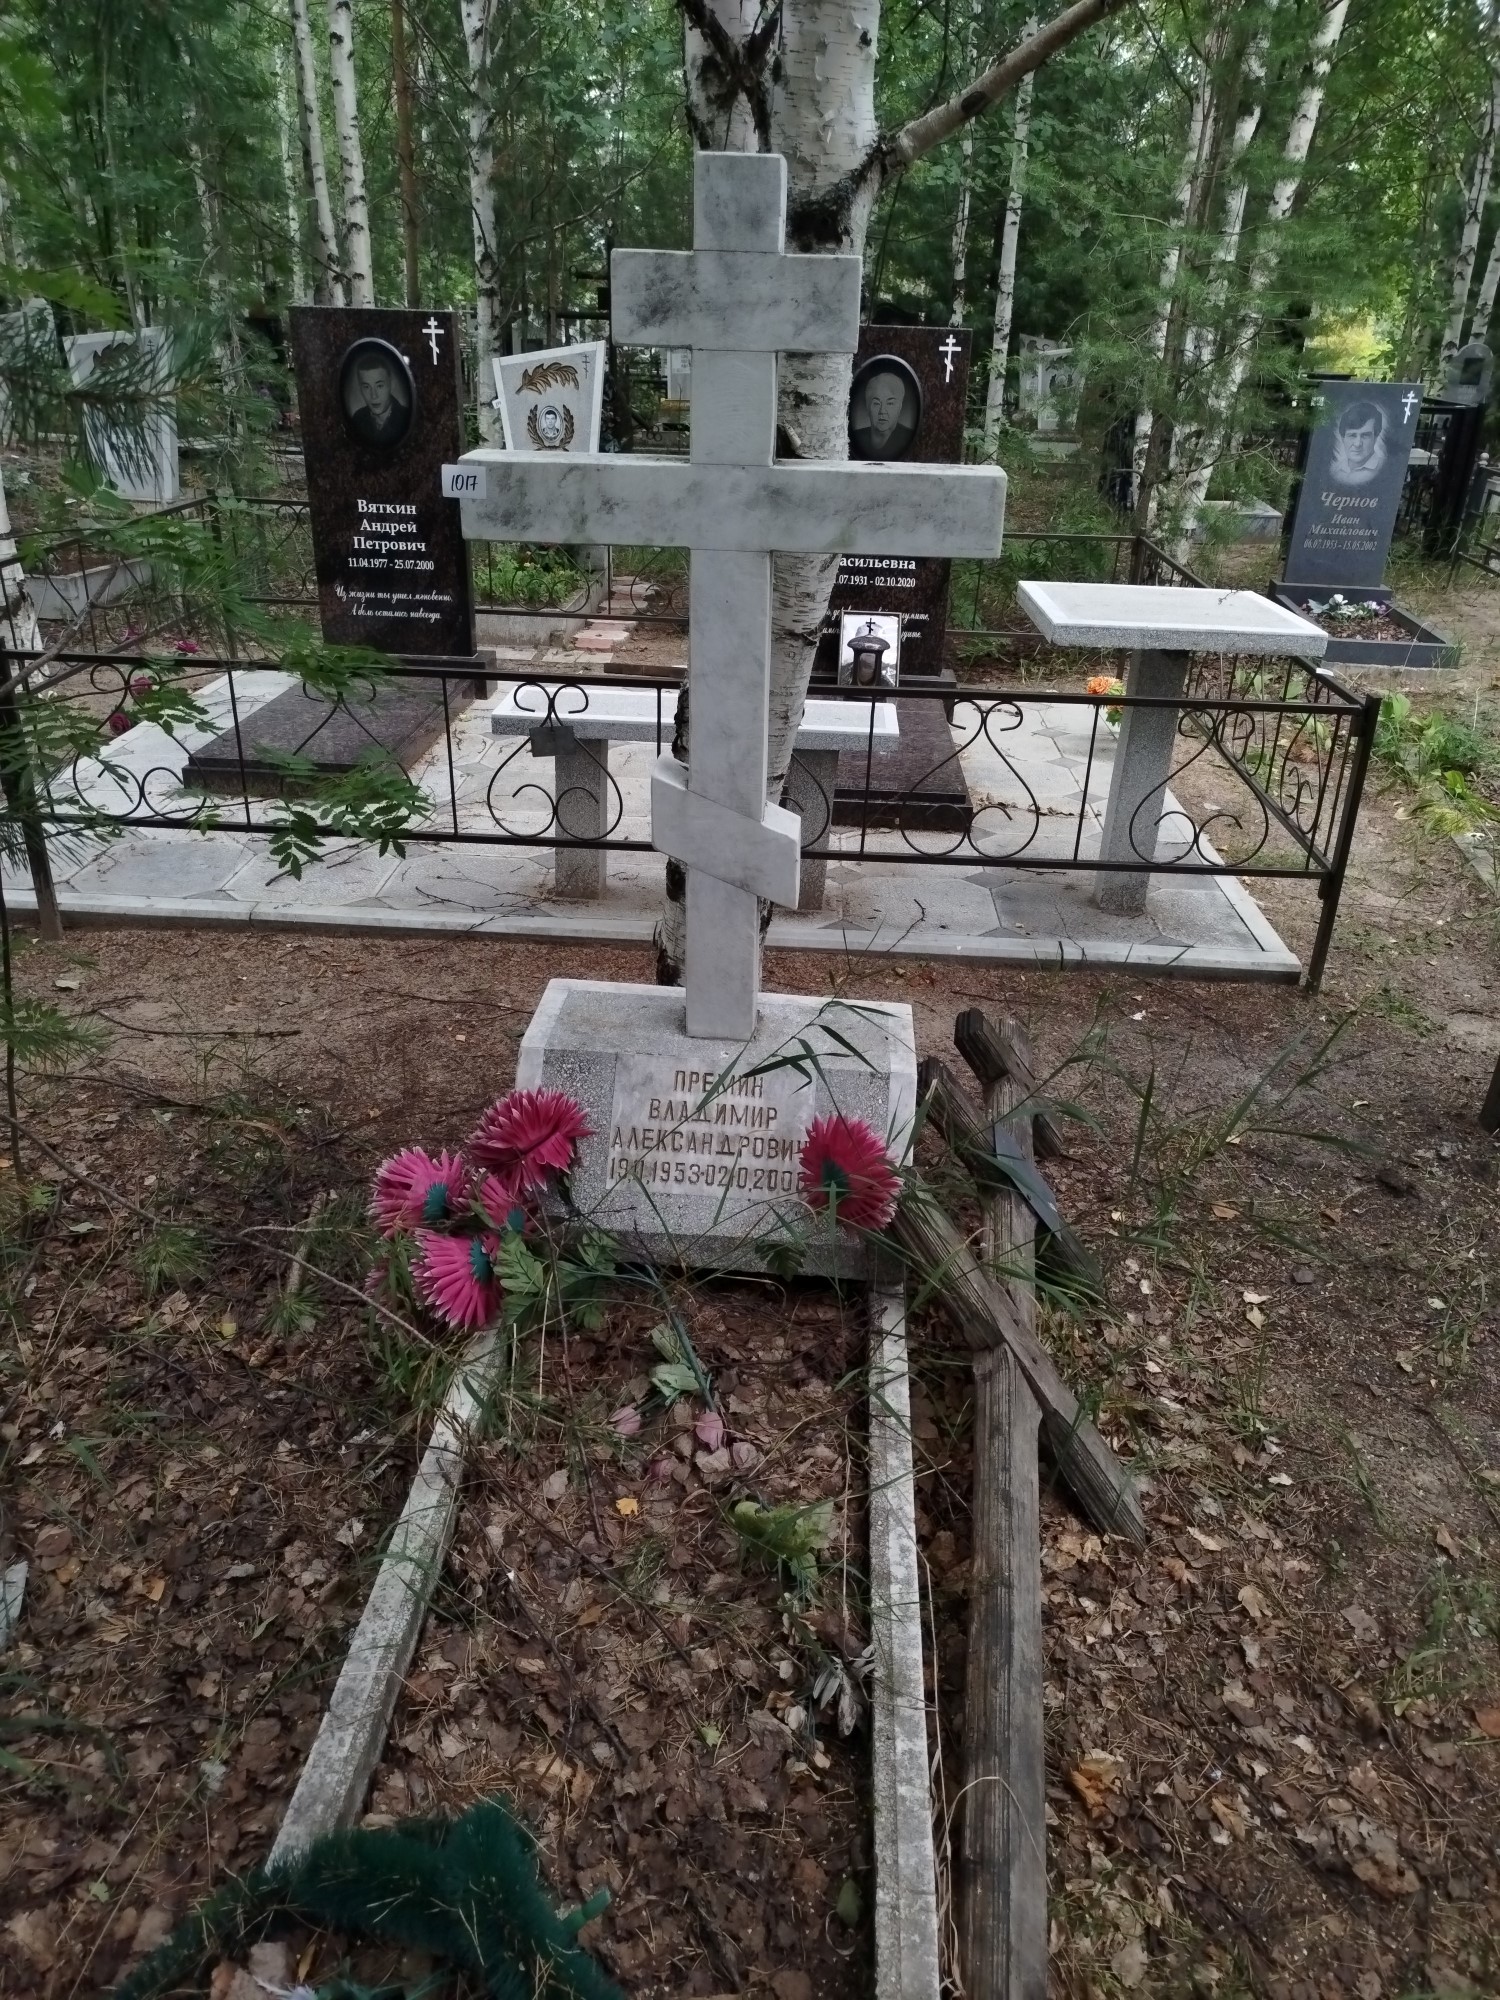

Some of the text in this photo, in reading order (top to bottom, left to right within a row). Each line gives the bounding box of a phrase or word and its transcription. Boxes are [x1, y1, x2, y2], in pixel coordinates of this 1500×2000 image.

[451, 474, 478, 492] 1017
[357, 499, 417, 515] Вяткин
[1321, 491, 1379, 511] Чернов
[360, 519, 417, 535] Андрей
[1330, 514, 1360, 525] Иван
[1308, 524, 1379, 537] Михайлович
[353, 536, 426, 553] Петрович
[348, 557, 388, 569] 11.04.1977
[394, 559, 435, 571] 25.07.2000
[840, 557, 917, 570] асильевна
[875, 576, 916, 588] 02.10.2020
[377, 591, 390, 599] ты
[649, 1098, 778, 1129] ВЛАДИМИР
